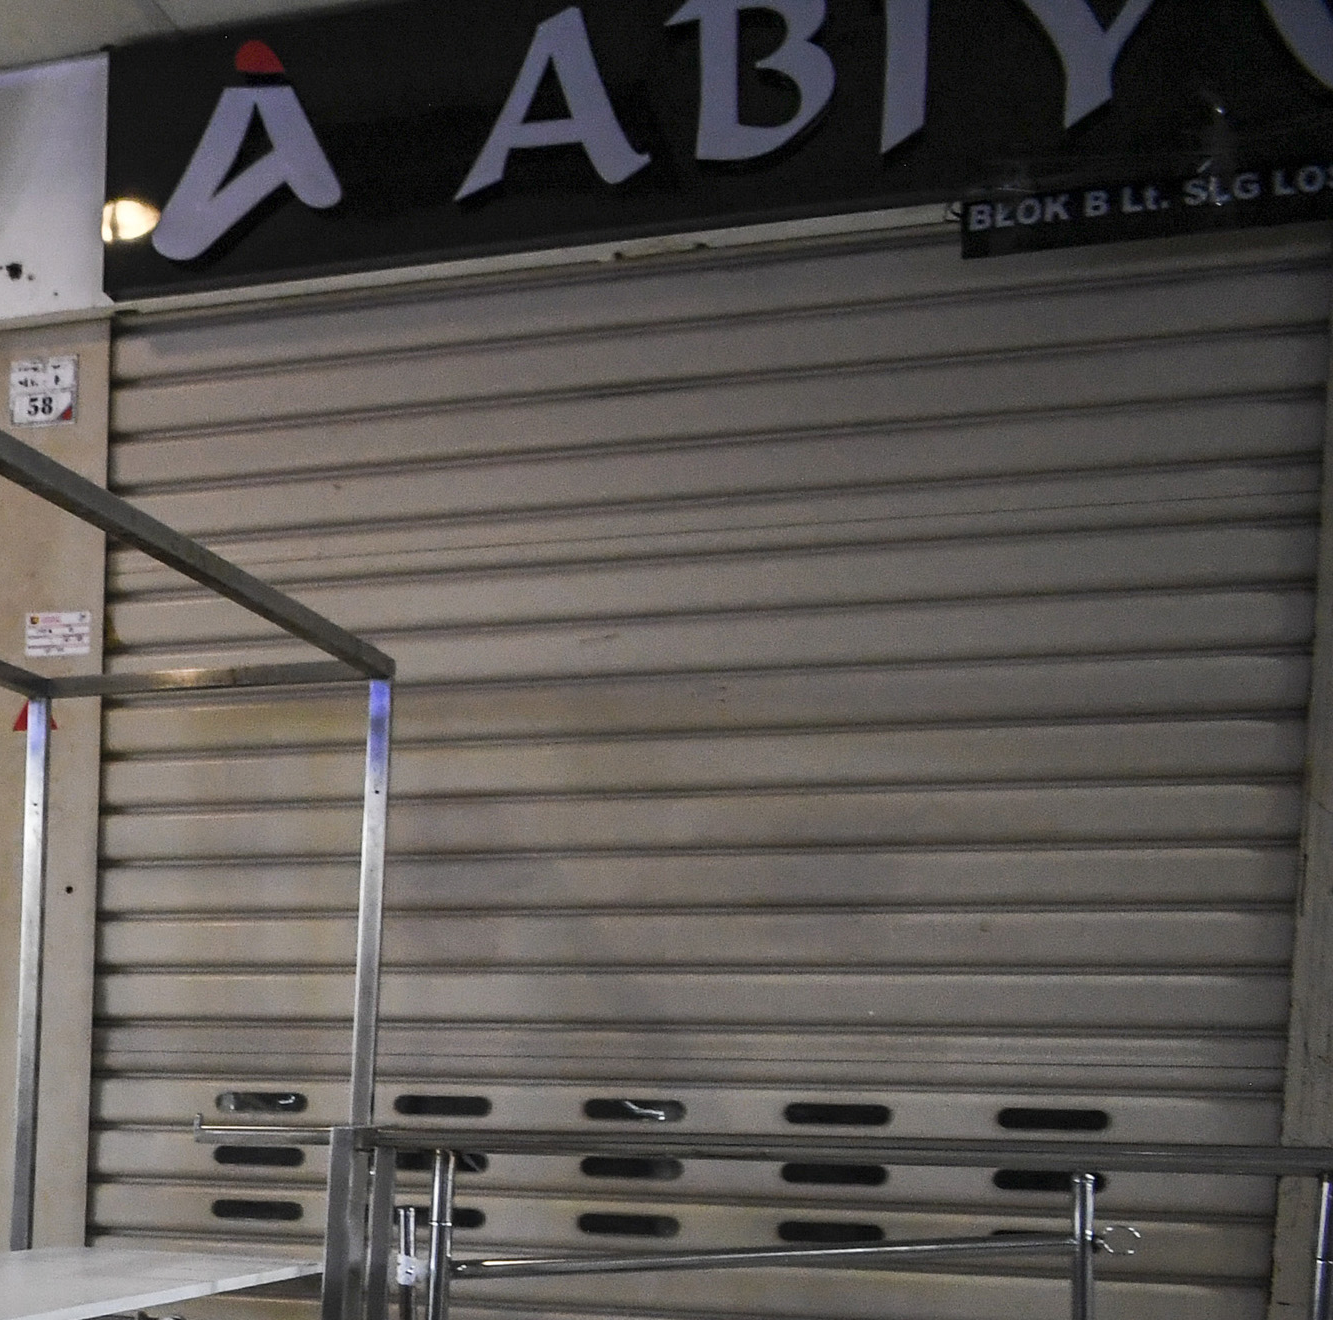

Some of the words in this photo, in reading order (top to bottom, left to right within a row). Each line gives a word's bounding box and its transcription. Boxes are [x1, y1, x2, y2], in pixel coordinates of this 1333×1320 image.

[454, 0, 1333, 200] ABIY
[968, 194, 1071, 232] BLOK
[1084, 189, 1110, 218] B
[1184, 172, 1263, 207] SLG
[1272, 163, 1333, 197] LO
[28, 396, 53, 416] 58
